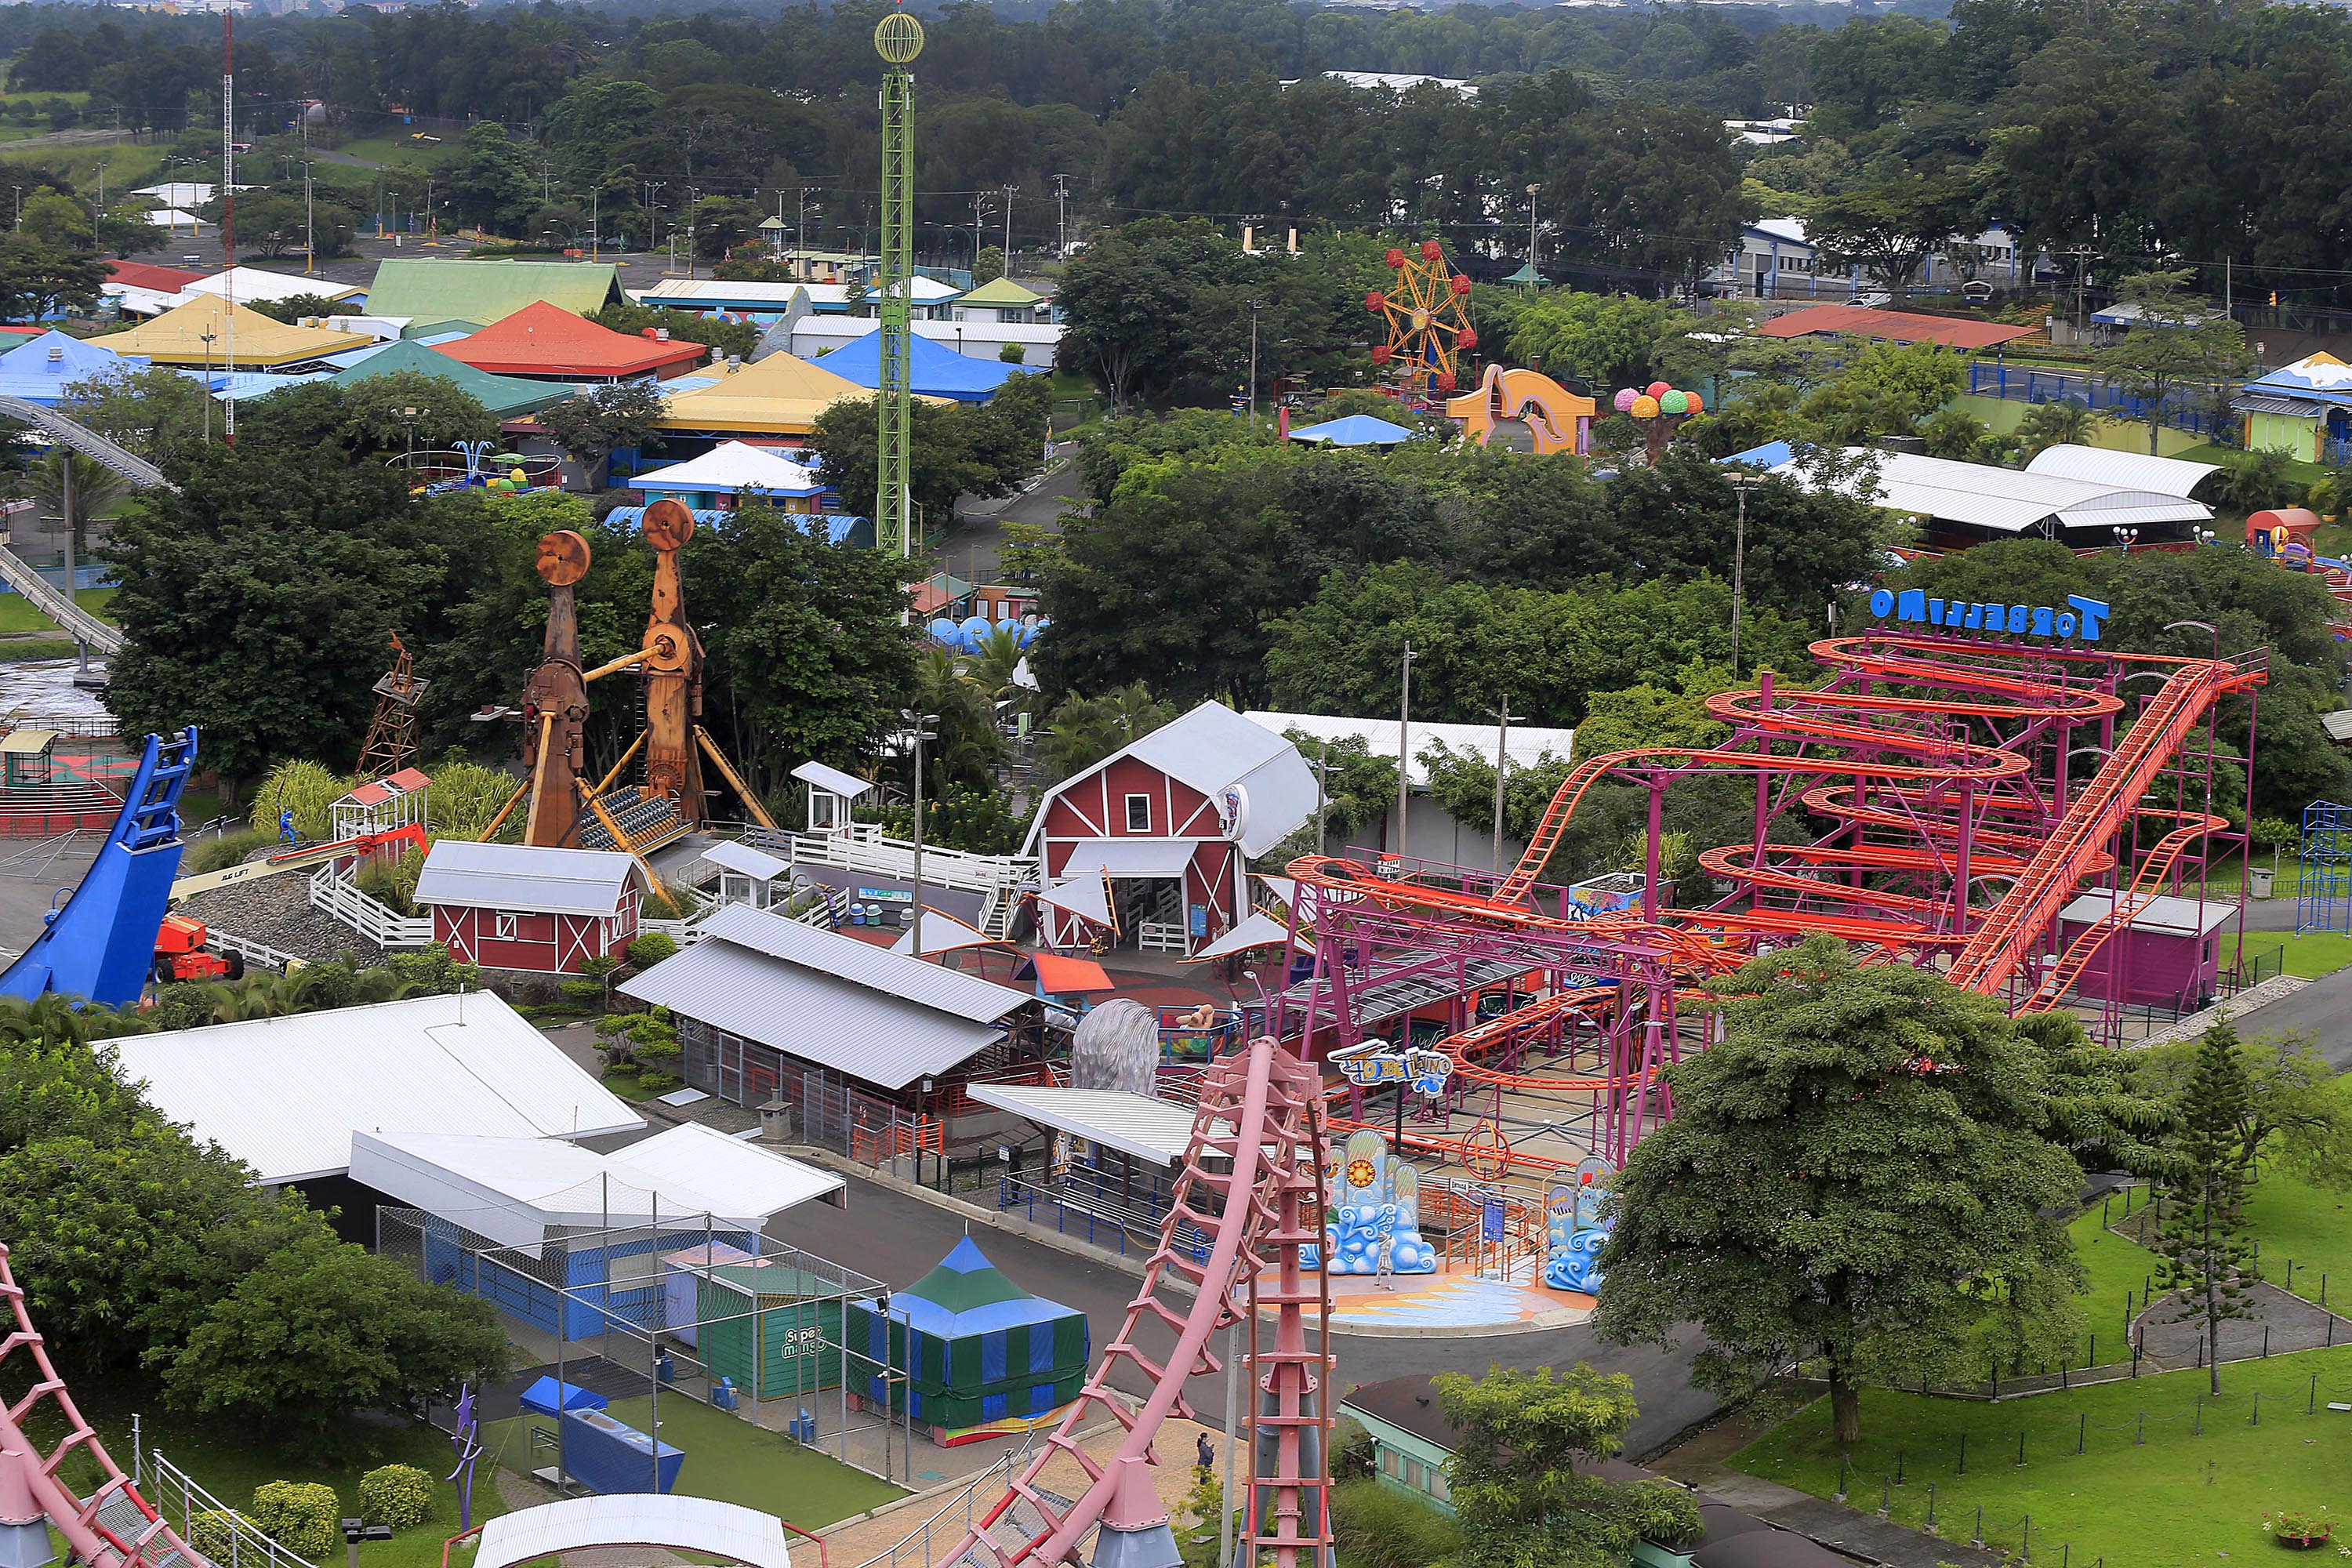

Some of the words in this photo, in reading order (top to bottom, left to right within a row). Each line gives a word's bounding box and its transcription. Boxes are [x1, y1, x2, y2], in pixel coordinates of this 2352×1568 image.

[220, 873, 234, 881] JLG
[234, 868, 250, 878] LIFT
[787, 1327, 821, 1343] Supe
